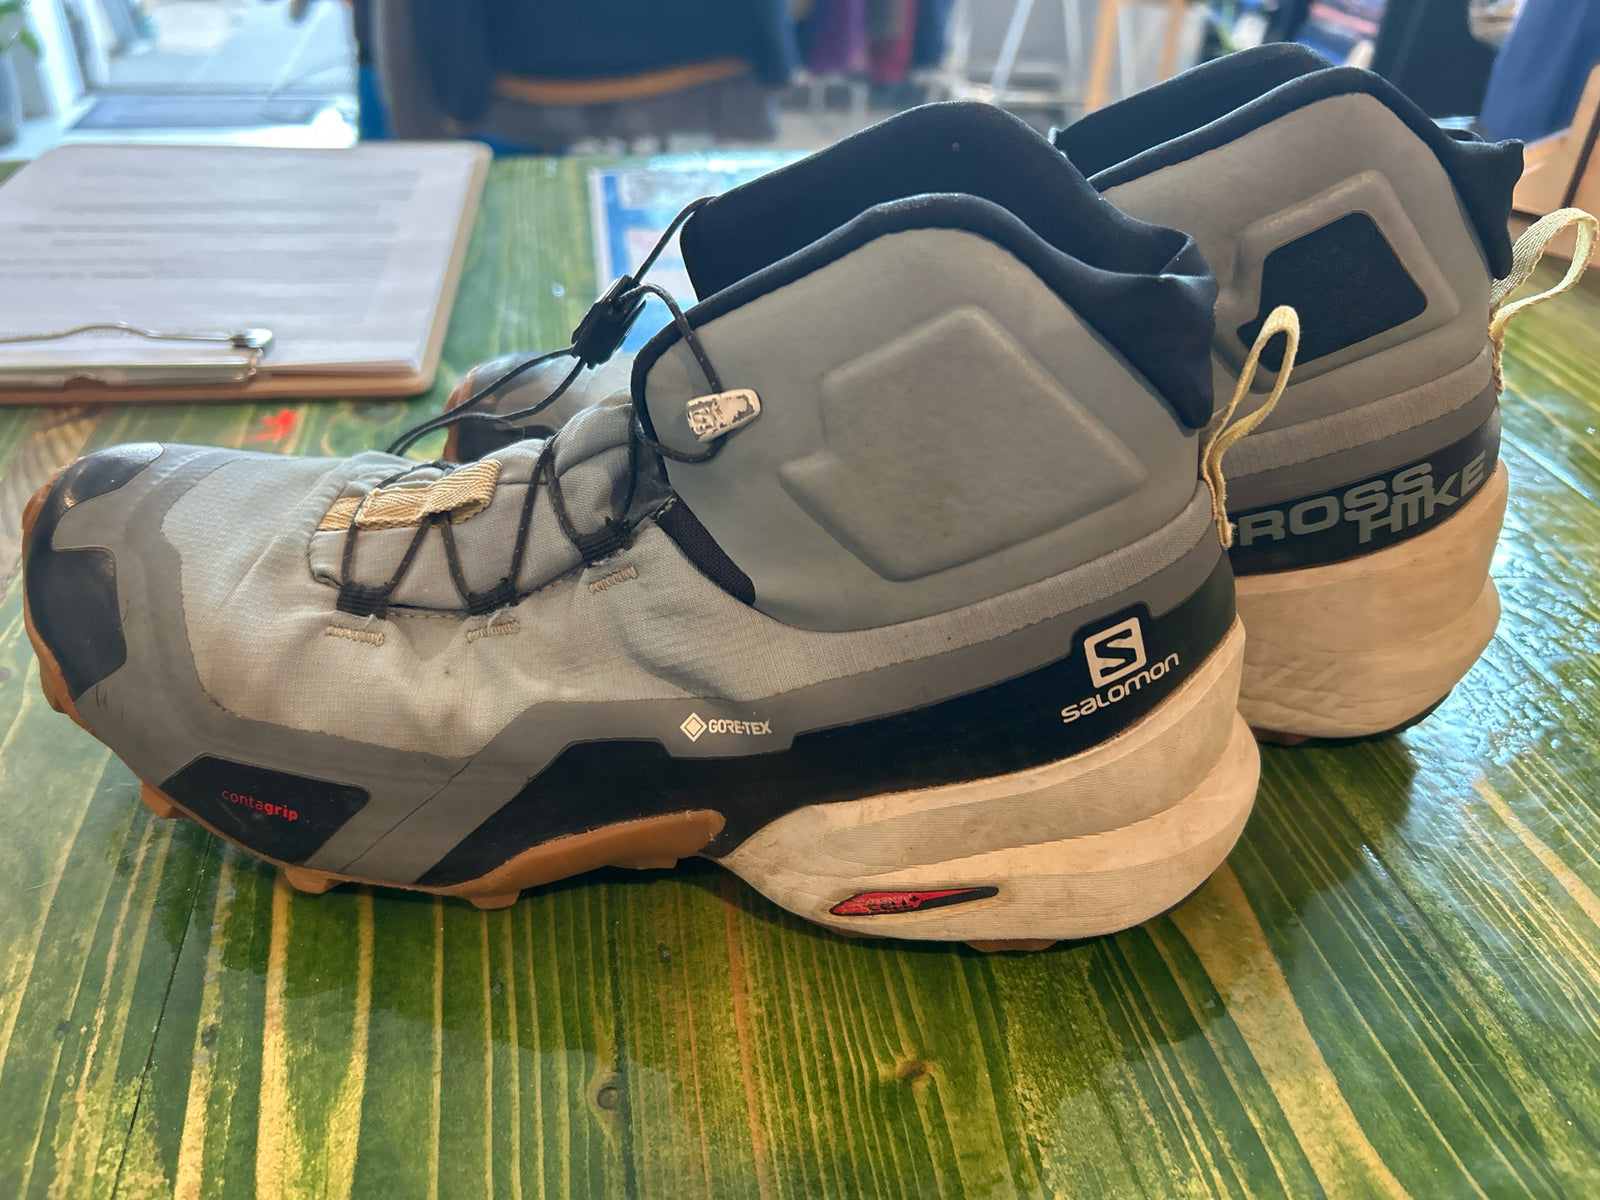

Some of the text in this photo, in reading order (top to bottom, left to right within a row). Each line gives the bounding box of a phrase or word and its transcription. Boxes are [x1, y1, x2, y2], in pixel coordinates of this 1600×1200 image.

[1238, 462, 1434, 546] ROSS
[1061, 652, 1180, 723] salomon
[708, 718, 773, 736] GORE-TEX
[221, 790, 299, 821] contagrip
